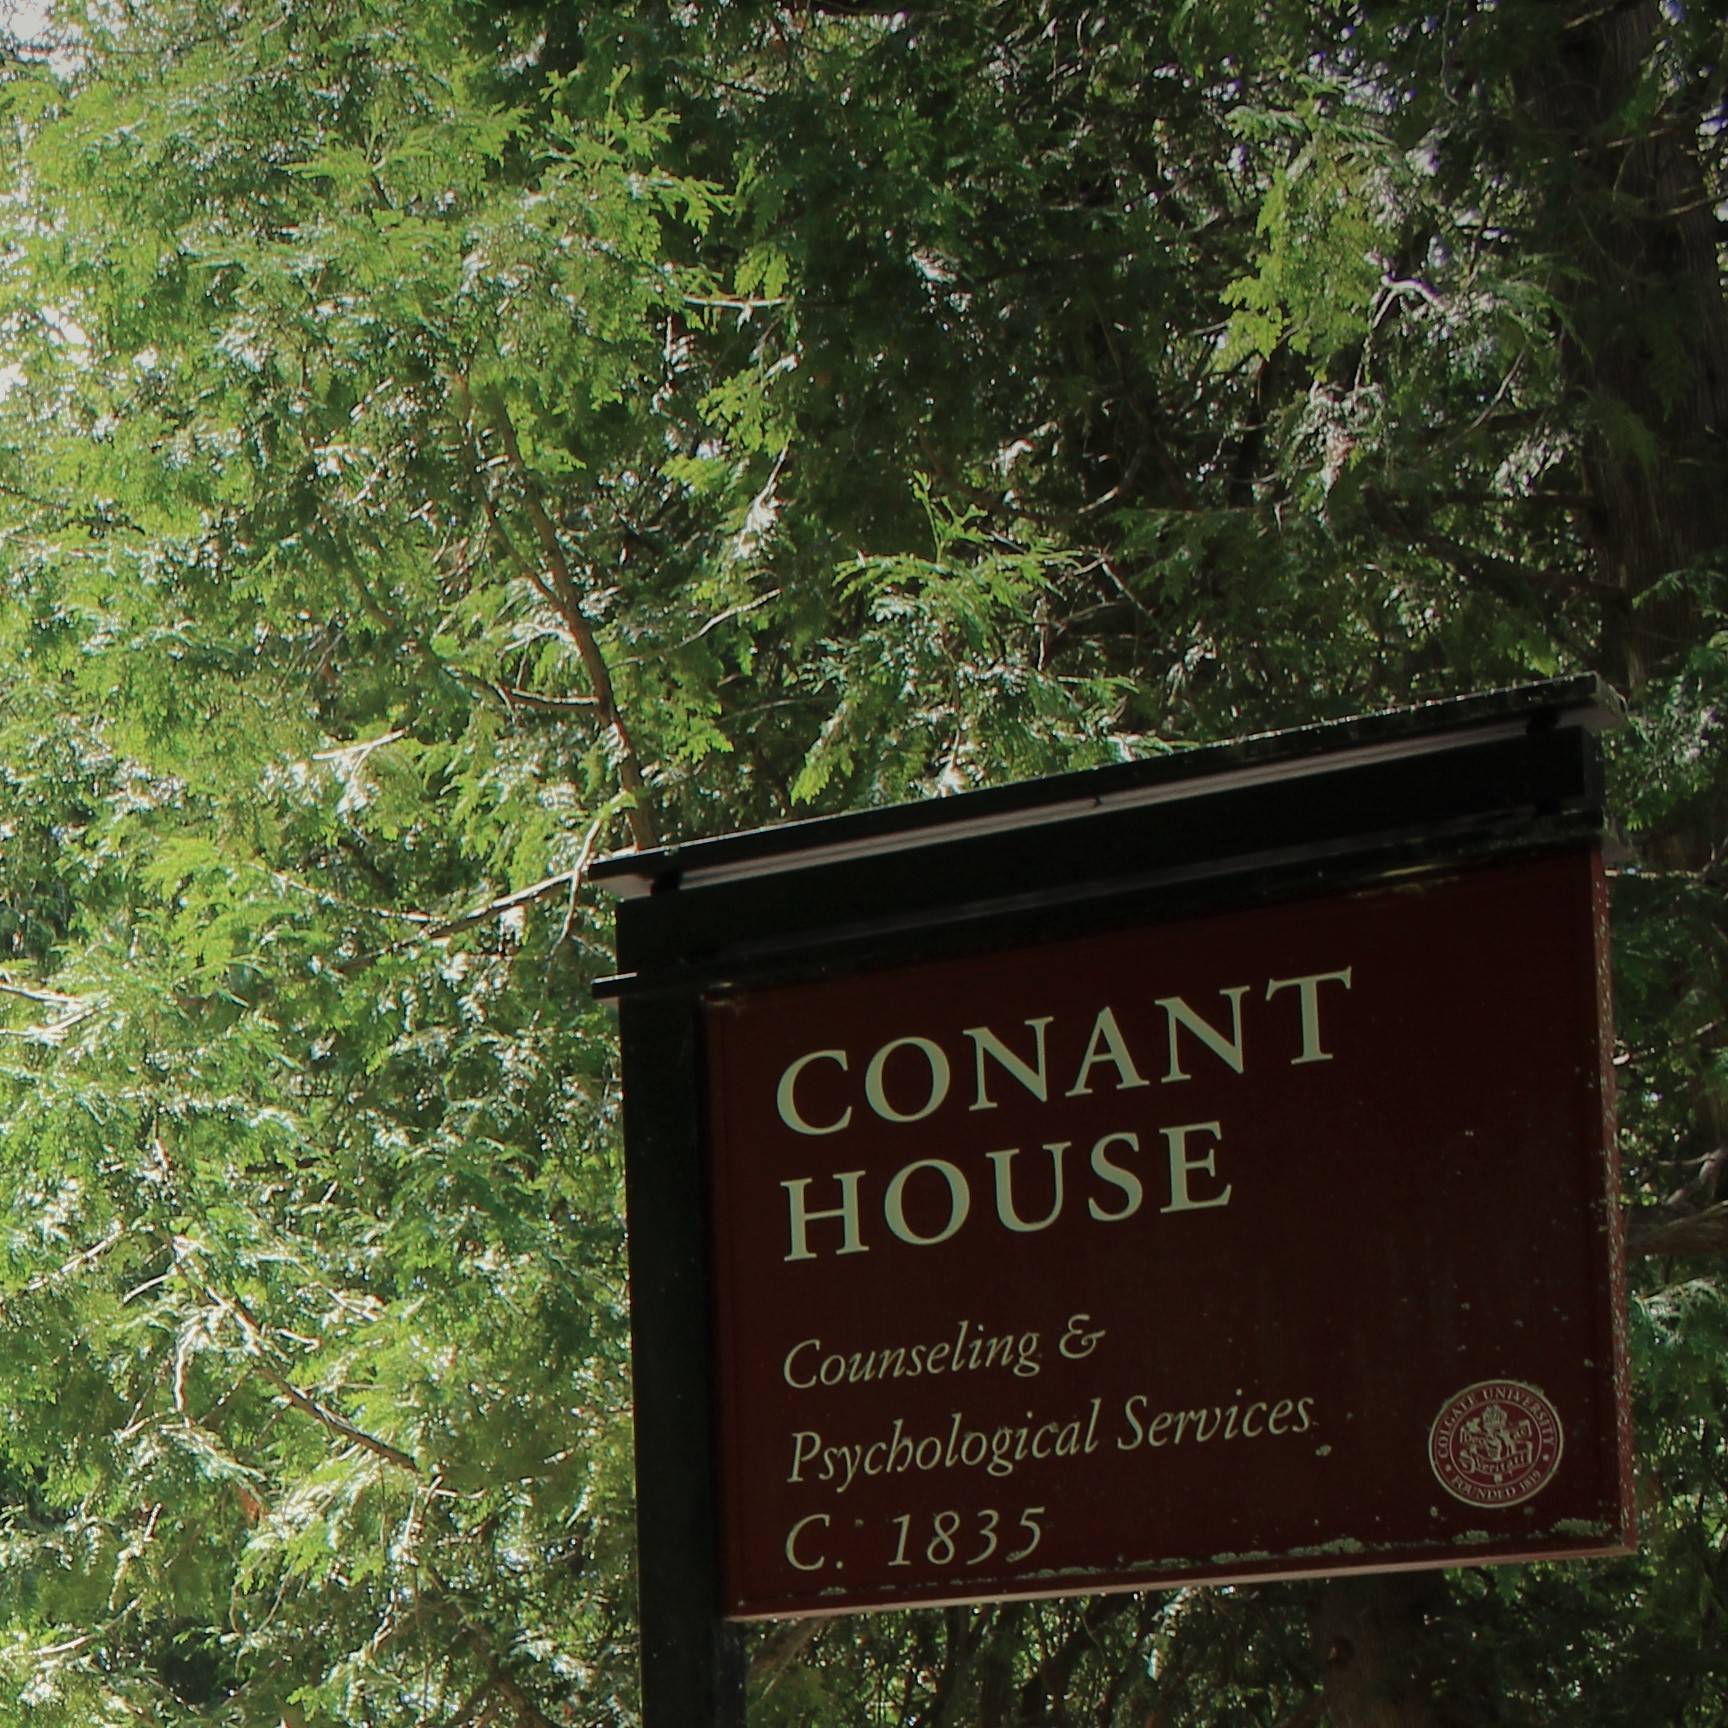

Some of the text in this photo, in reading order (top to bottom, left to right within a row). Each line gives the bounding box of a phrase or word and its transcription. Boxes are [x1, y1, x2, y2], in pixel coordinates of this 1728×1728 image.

[776, 965, 1352, 1136] CONANT
[779, 1120, 1233, 1262] HOUSE
[783, 1313, 1107, 1389] Counseling &
[785, 1388, 1315, 1494] Psychological Services
[1438, 1387, 1554, 1459] COLGATE UNIVERSITY
[1452, 1475, 1517, 1498] FOUNDED
[785, 1506, 1045, 1571] C. 1835
